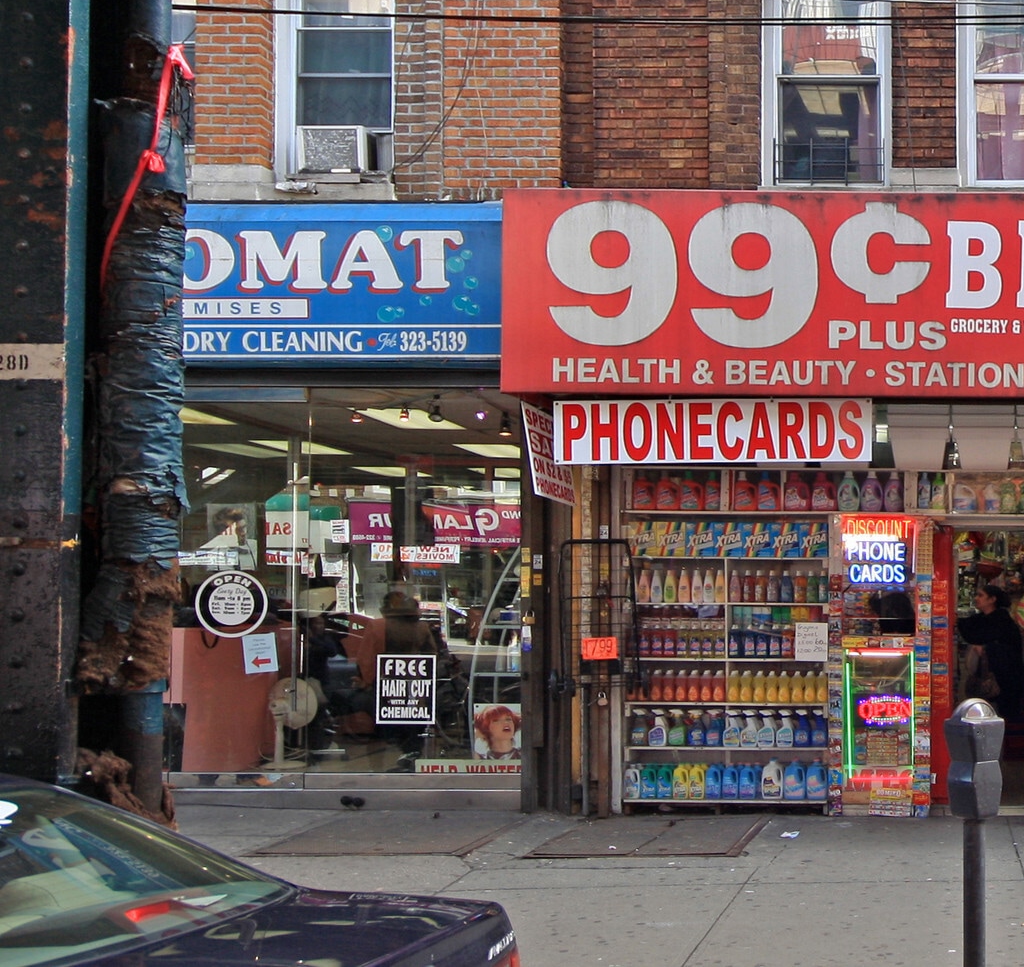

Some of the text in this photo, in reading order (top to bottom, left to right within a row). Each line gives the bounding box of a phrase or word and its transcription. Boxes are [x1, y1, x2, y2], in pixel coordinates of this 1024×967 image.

[546, 200, 931, 349] 99¢
[951, 318, 1008, 334] GROCERY
[1012, 320, 1021, 334] &
[242, 331, 363, 352] CLEANING
[400, 330, 467, 352] 323-5139
[828, 320, 947, 350] PLUS
[552, 357, 680, 384] HEALTH
[692, 359, 714, 385] &
[725, 360, 856, 386] BEAUTY
[562, 400, 866, 462] PHONECARDS
[847, 519, 911, 538] DISCOUNT
[688, 532, 713, 547] XTRA
[716, 532, 742, 547] XTRA
[744, 533, 770, 547] XTRA
[773, 533, 798, 547] XTRA
[801, 533, 826, 547] XTRA
[846, 541, 905, 561] PHONE
[213, 575, 252, 588] OPEN
[849, 564, 905, 582] CARDS
[384, 659, 427, 676] FREE
[381, 680, 431, 697] HAIR CUT
[380, 706, 430, 719] CHEMICAL
[859, 701, 911, 720] OPEN
